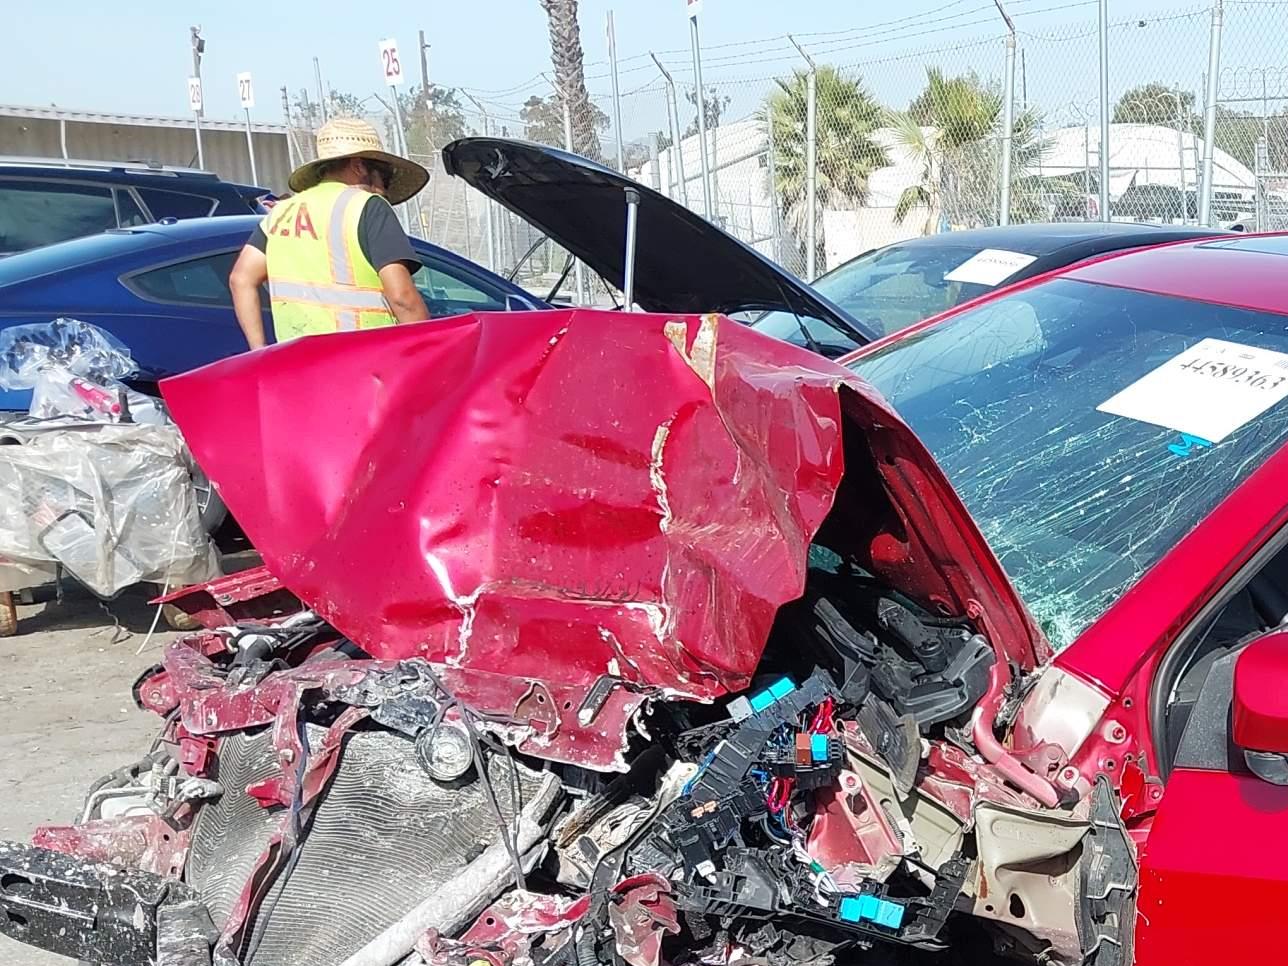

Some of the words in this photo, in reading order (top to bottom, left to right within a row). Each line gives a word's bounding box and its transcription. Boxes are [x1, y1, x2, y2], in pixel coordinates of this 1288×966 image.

[382, 48, 401, 77] 25
[239, 79, 251, 101] 27
[1180, 357, 1286, 390] 44589363
